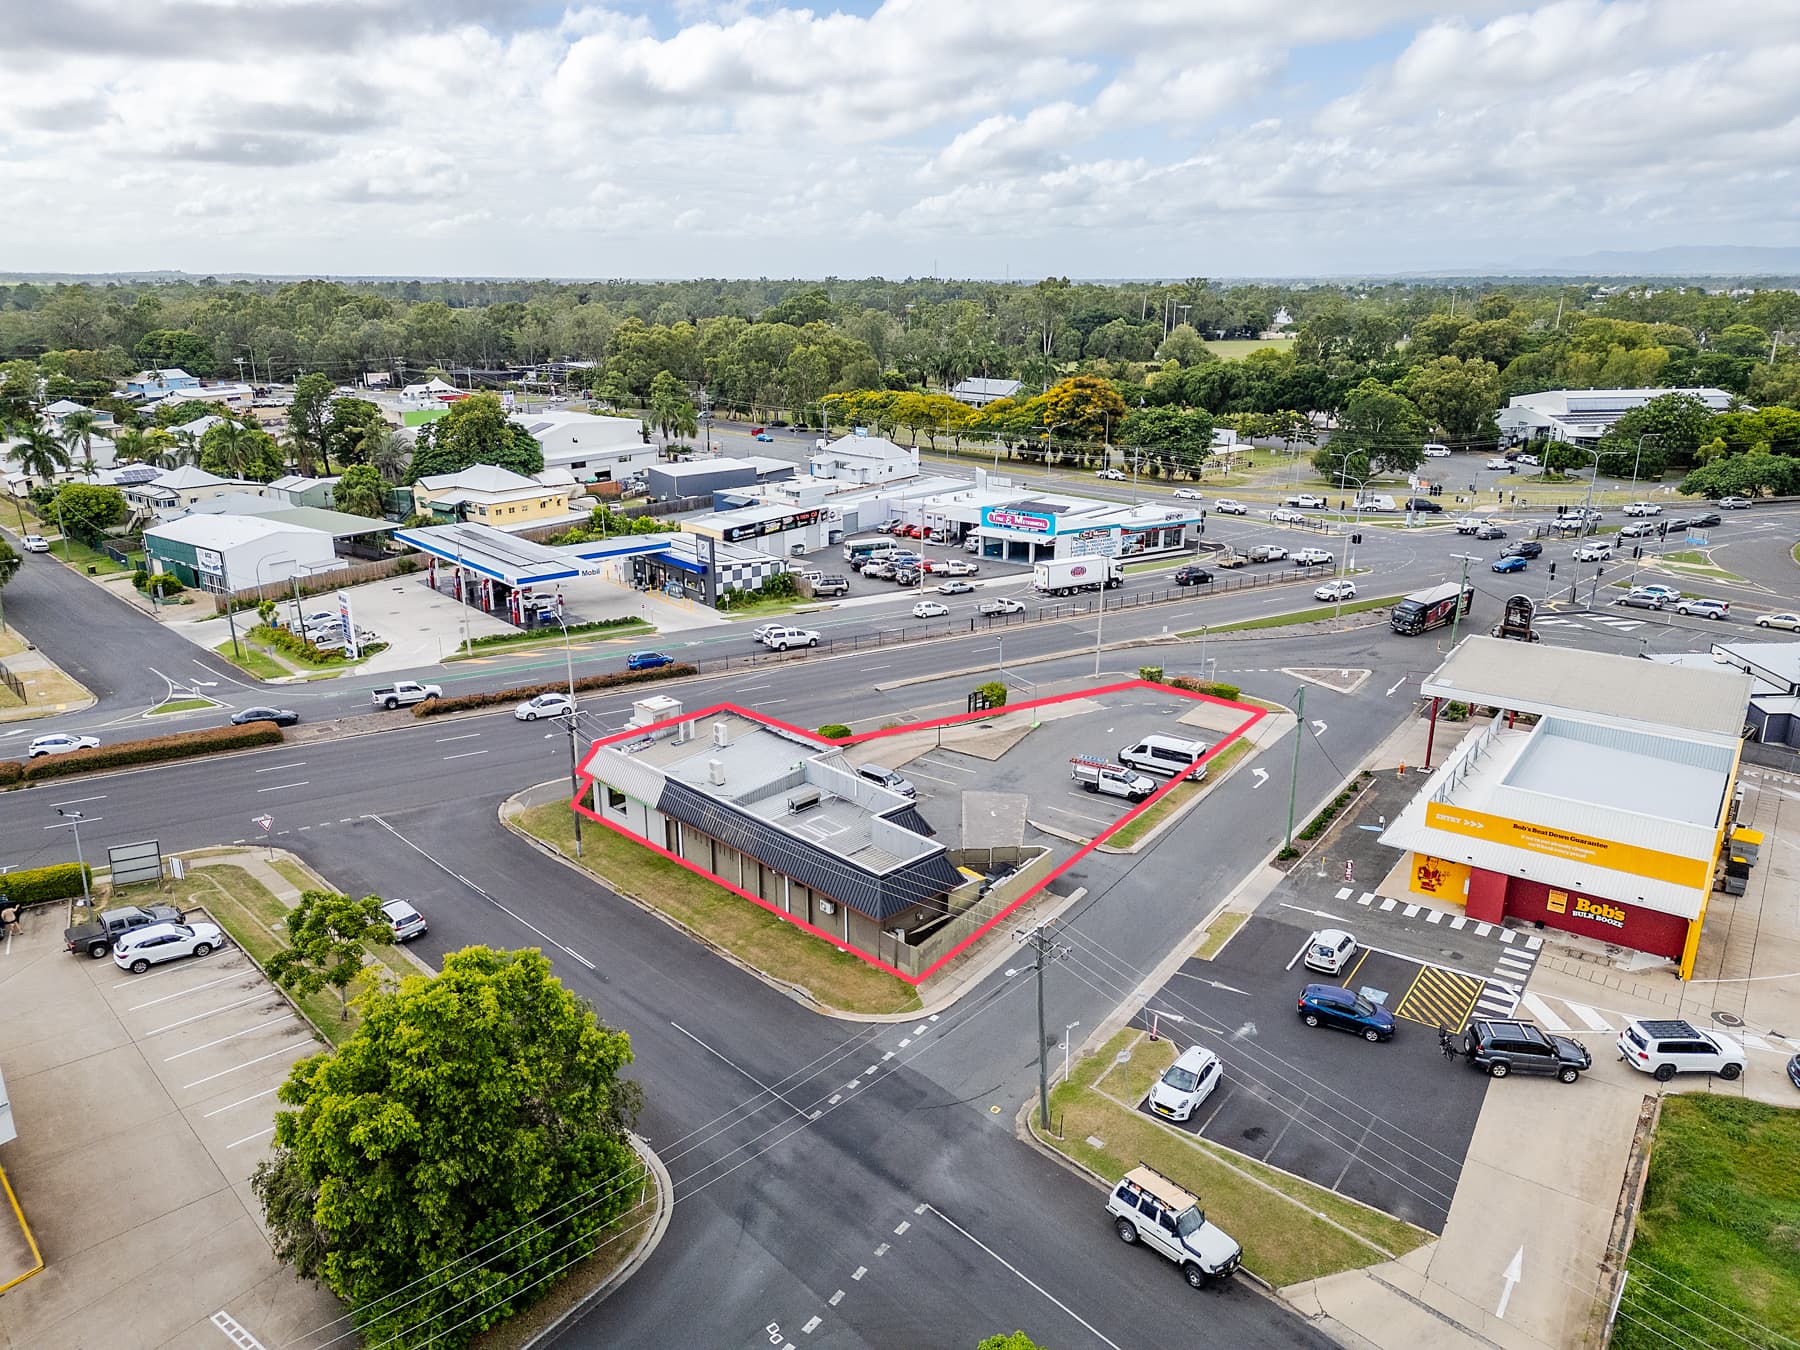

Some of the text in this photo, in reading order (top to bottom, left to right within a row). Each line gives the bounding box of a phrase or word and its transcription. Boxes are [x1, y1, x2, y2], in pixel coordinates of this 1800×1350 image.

[581, 568, 600, 577] Mobil
[1512, 823, 1531, 832] Bob's
[1549, 831, 1570, 841] Down
[1570, 836, 1608, 849] Guarantee
[1572, 910, 1624, 928] BULK BOOZE
[1575, 898, 1625, 921] Bob's
